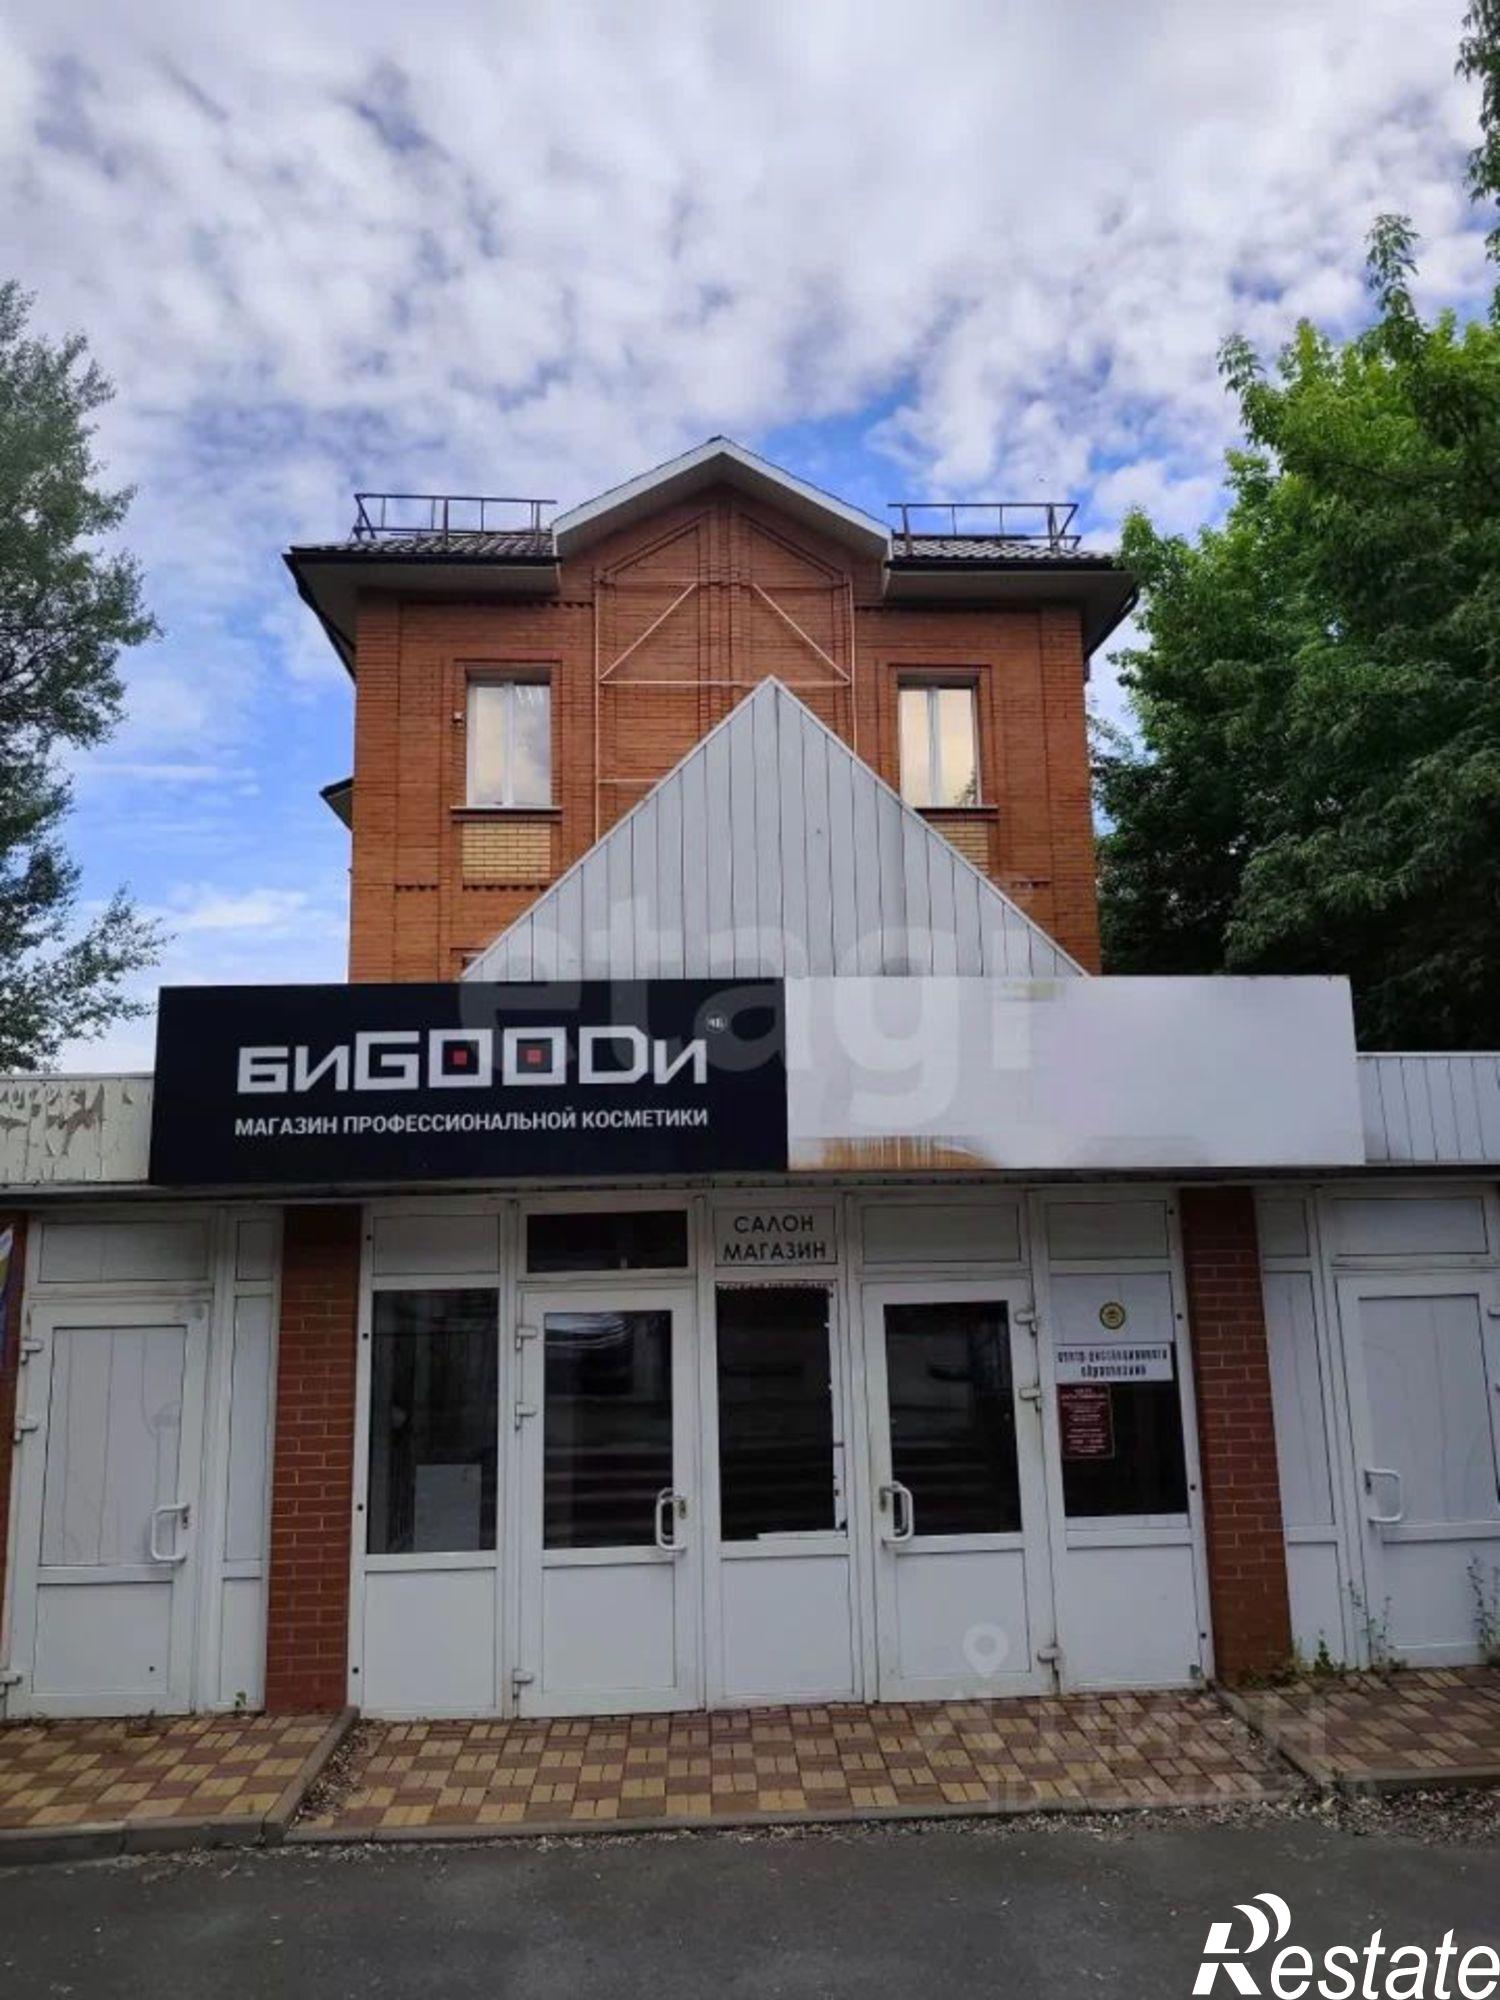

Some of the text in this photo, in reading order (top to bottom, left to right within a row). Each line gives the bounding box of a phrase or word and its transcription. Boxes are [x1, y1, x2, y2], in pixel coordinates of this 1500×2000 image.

[234, 1105, 709, 1137] МАГАЗИН ПРОФЕССИОНАЛЬНОЙ КОСМЕТИКИ
[733, 1214, 814, 1234] САЛОН
[722, 1241, 826, 1261] МАГАЗИН
